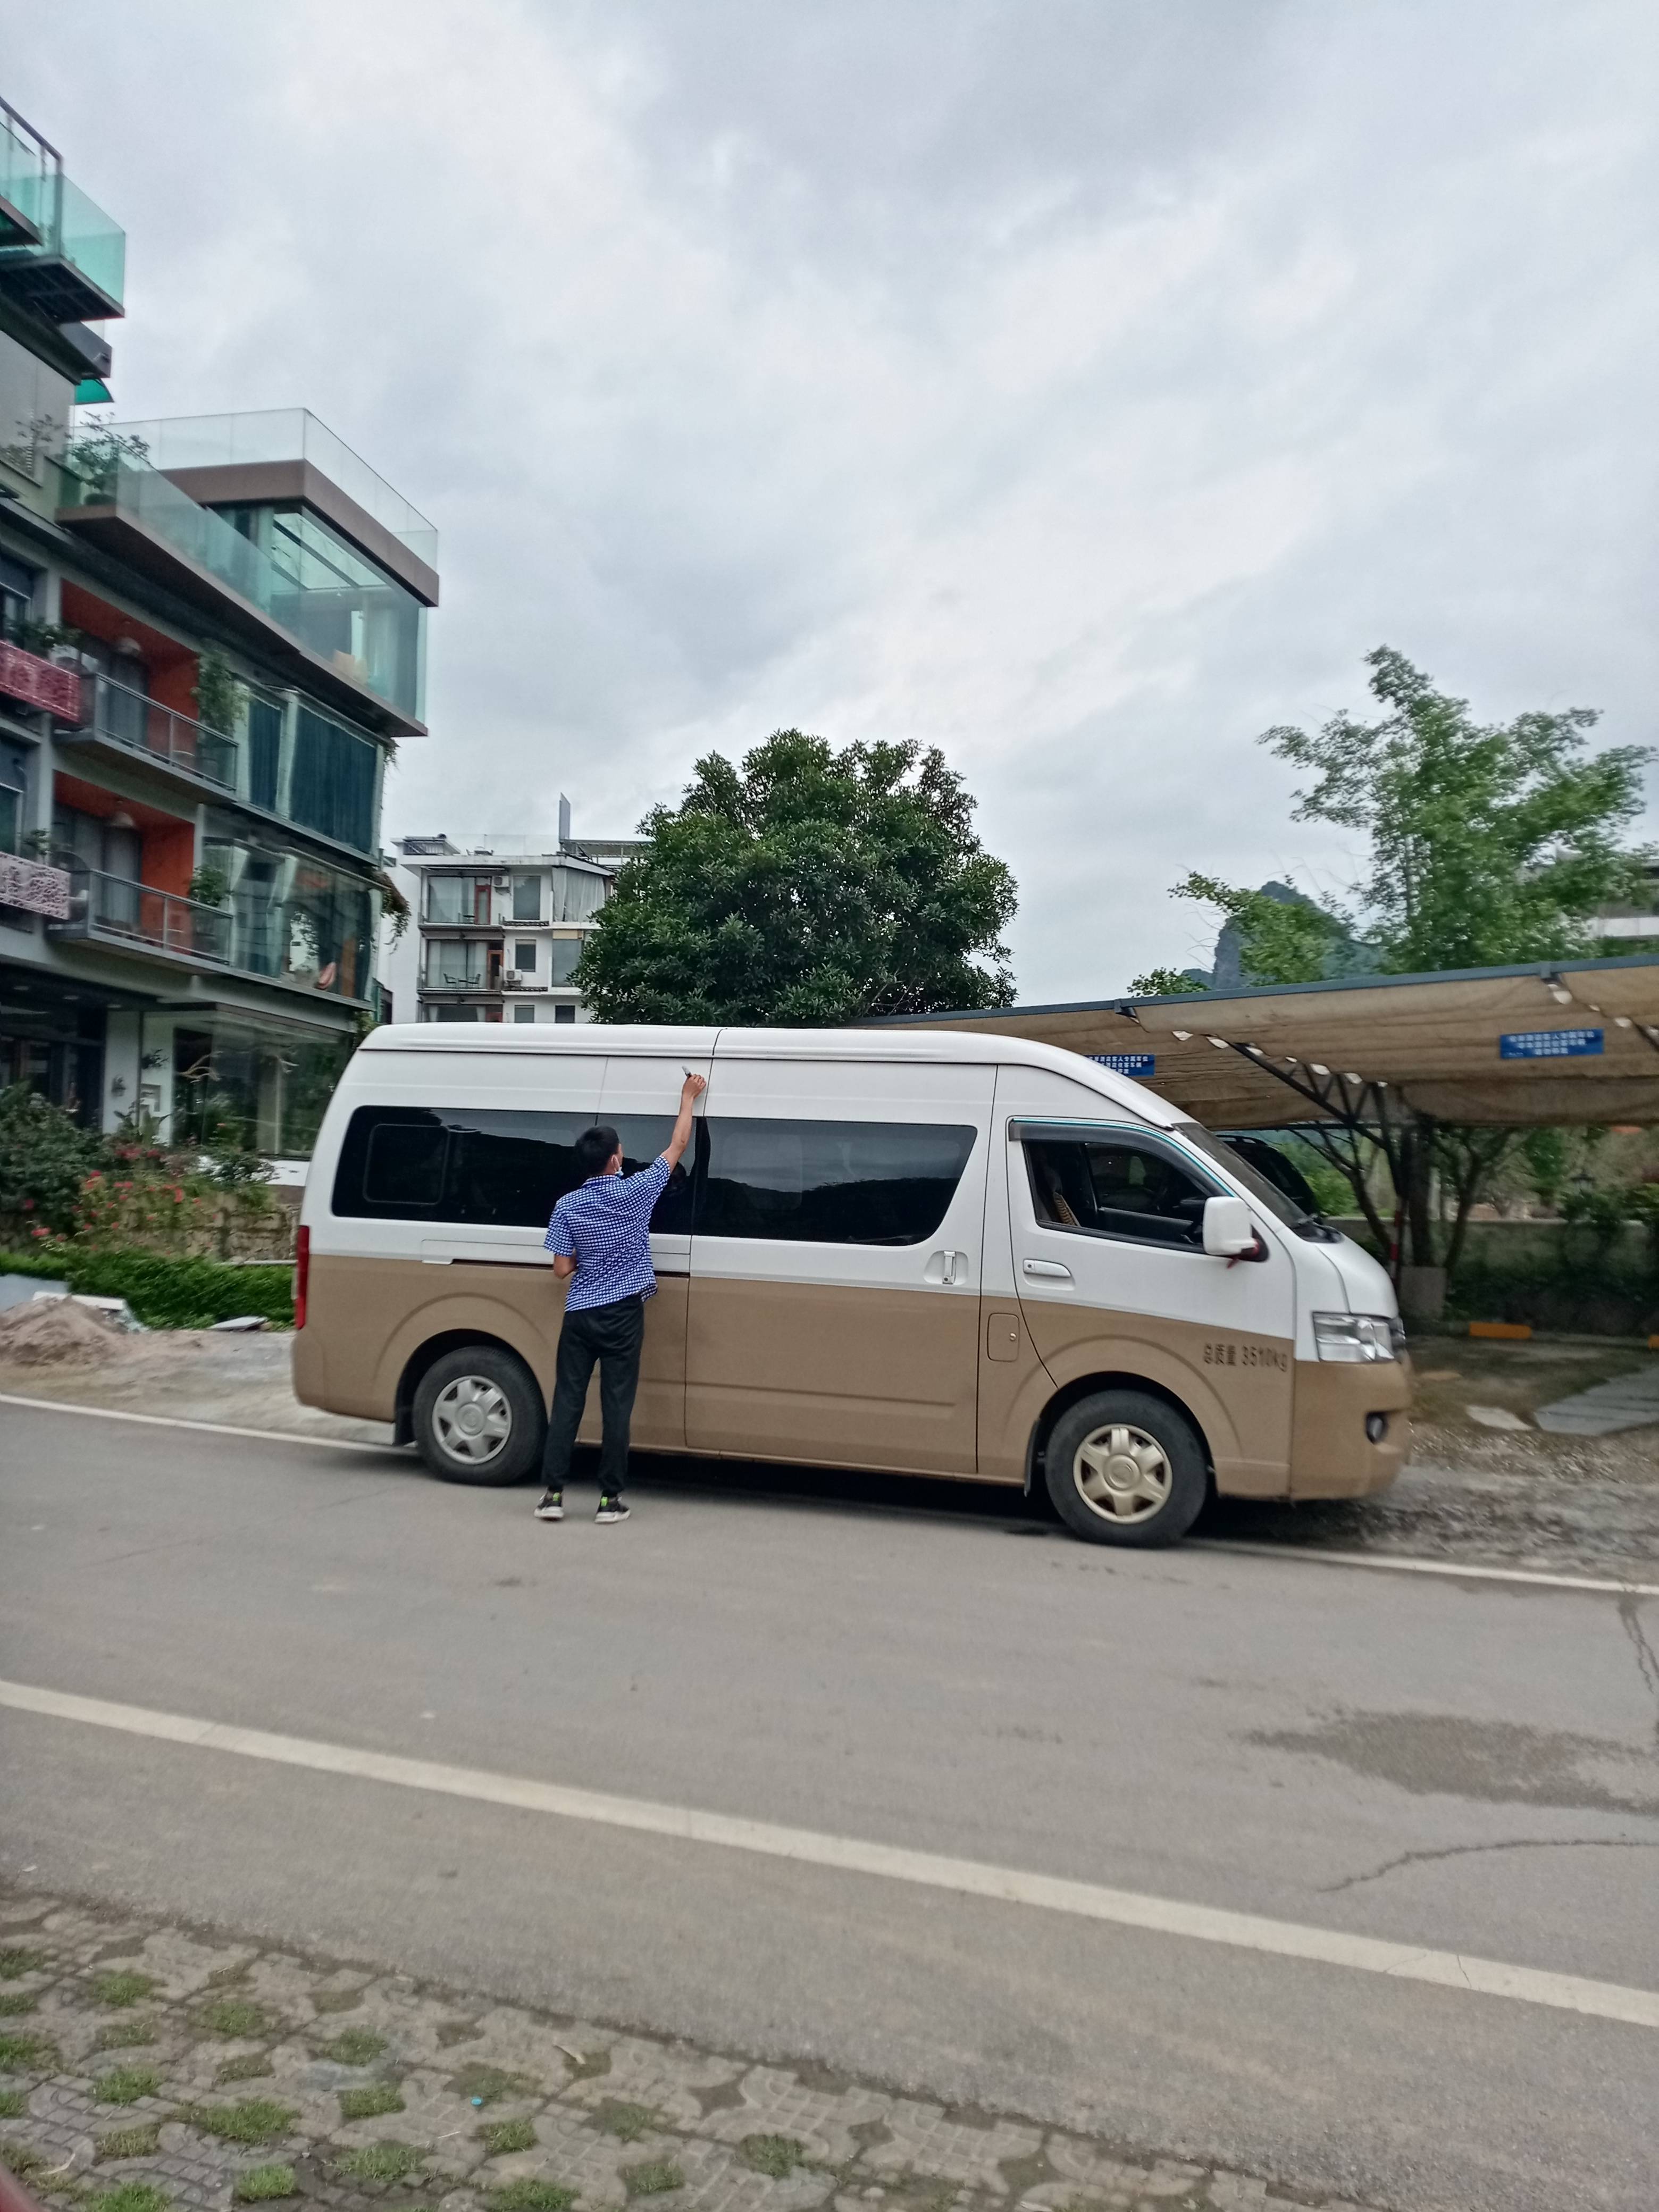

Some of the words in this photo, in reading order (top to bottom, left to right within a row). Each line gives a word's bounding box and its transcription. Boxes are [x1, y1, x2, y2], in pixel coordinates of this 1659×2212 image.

[1203, 1344, 1237, 1366] 总质量
[1242, 1345, 1287, 1372] 3510kg
